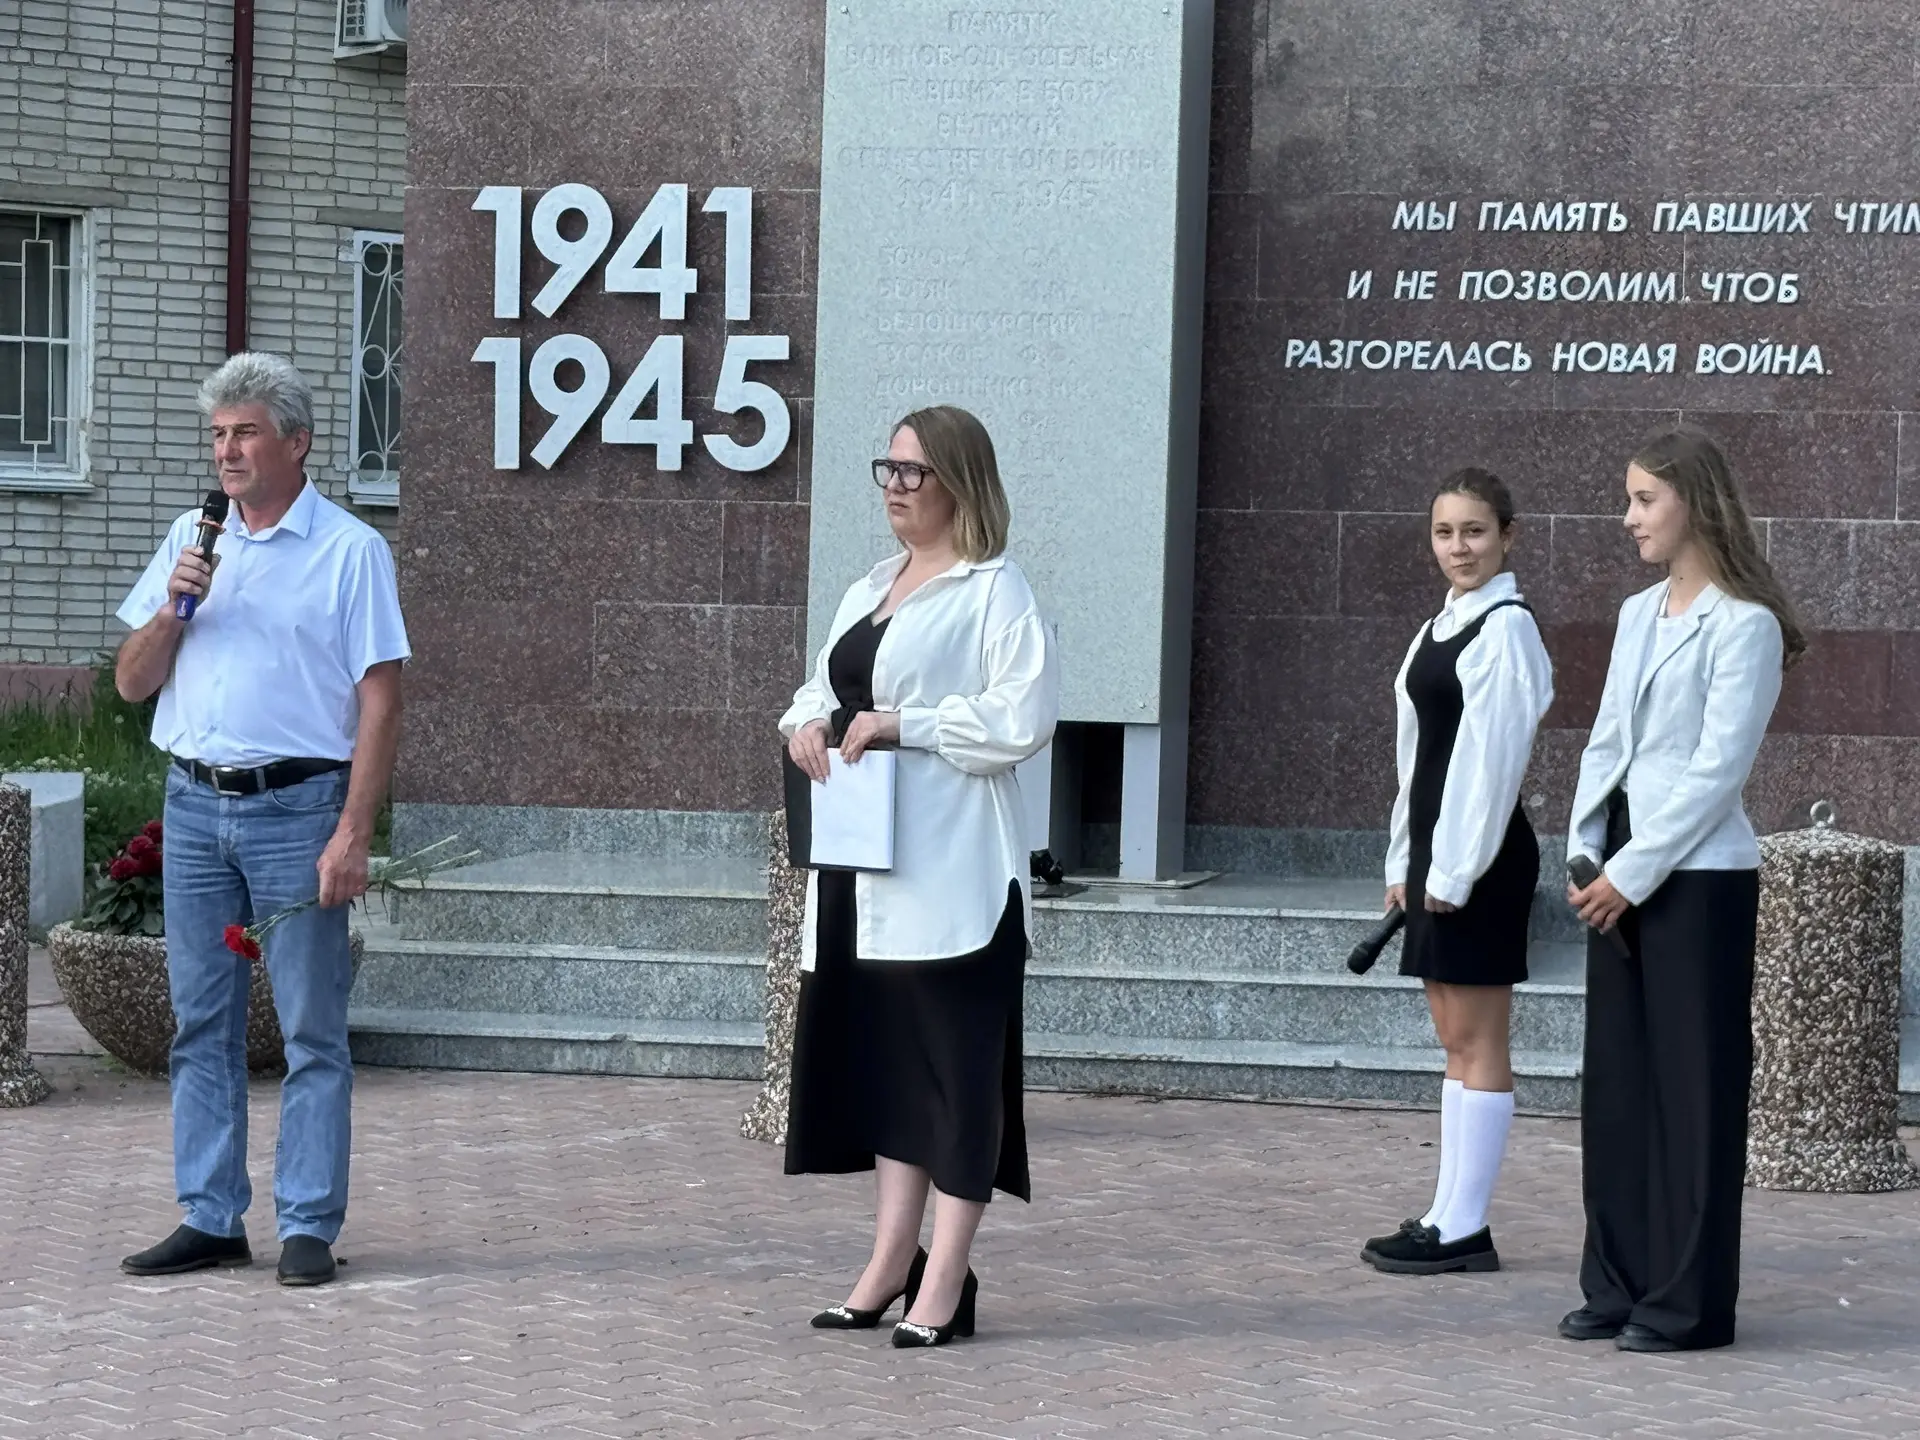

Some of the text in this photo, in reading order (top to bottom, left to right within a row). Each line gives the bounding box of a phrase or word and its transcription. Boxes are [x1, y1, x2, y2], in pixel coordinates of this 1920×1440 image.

[1392, 202, 1455, 231] МЫ
[1477, 202, 1628, 232] ПАМЯТЬ
[1653, 202, 1810, 233] ПАВШИХ
[471, 183, 752, 320] 1941
[1347, 271, 1799, 304] И НЕ ПОЗВОЛИМ ЧТОБ
[1284, 338, 1833, 375] РАЗГОРЕЛАСЬ НОВАЯ ВОЙНА.
[470, 334, 791, 472] 1945
